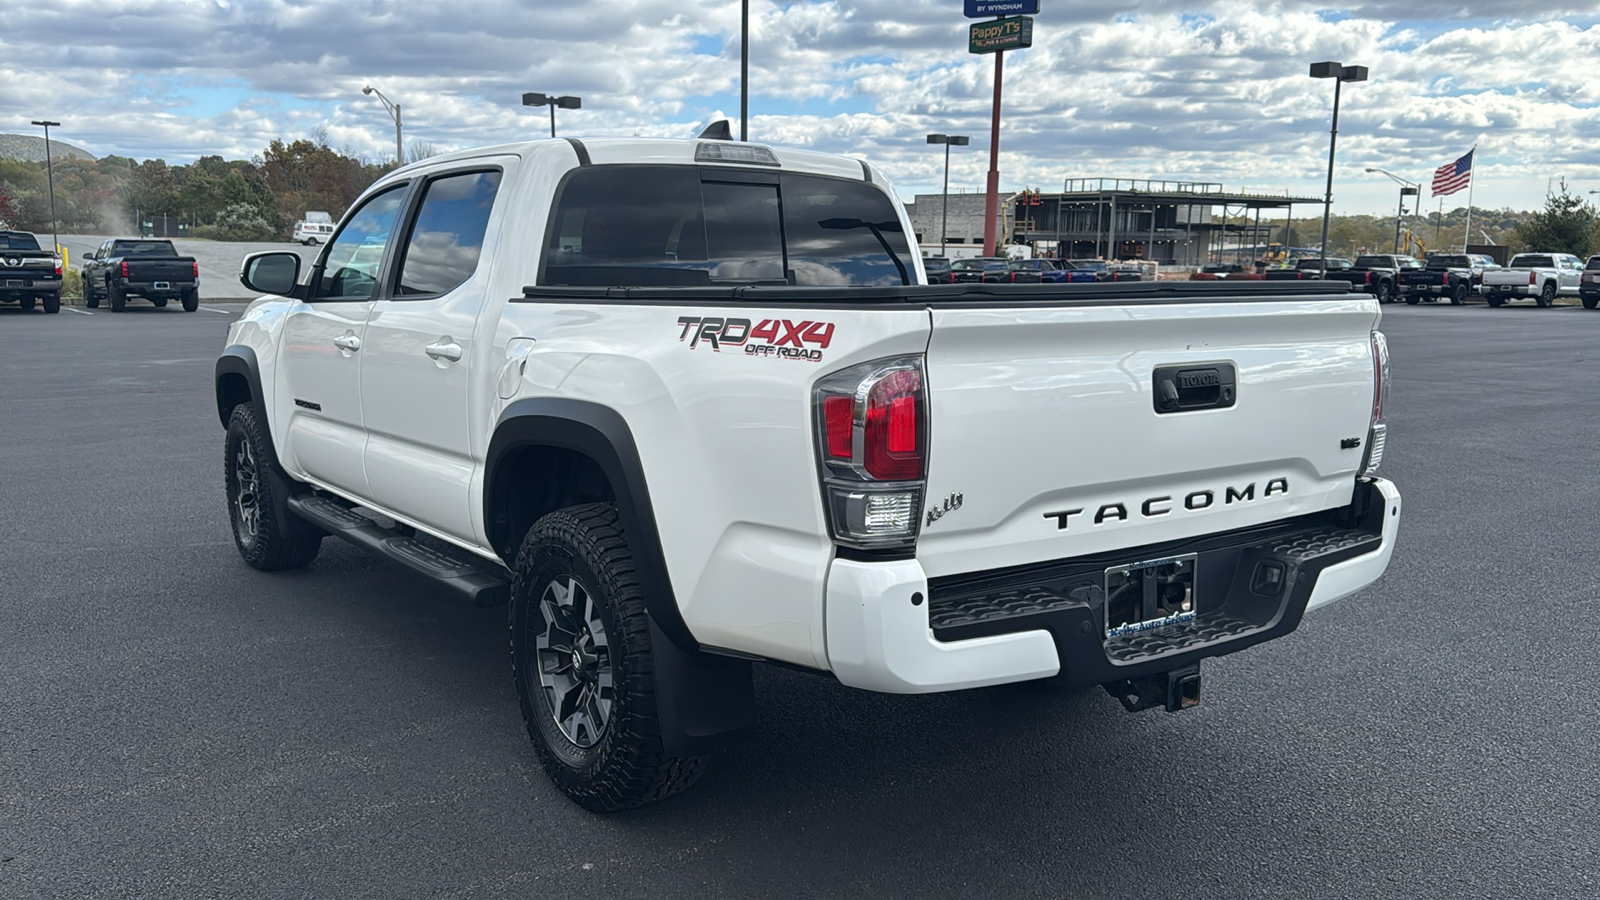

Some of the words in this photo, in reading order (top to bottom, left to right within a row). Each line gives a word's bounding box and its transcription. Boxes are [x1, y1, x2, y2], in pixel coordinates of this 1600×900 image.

[988, 3, 1022, 11] WYNDHAM
[972, 26, 1003, 39] Pappy
[1004, 22, 1020, 33] T's
[677, 316, 751, 352] TRD
[744, 344, 776, 357] OFF
[777, 347, 823, 362] ROAD
[1183, 373, 1220, 386] TOYOTA
[1043, 477, 1288, 530] TACOMA
[1108, 625, 1136, 637] Kelly
[1139, 620, 1161, 630] Auto
[1164, 614, 1193, 626] Group
